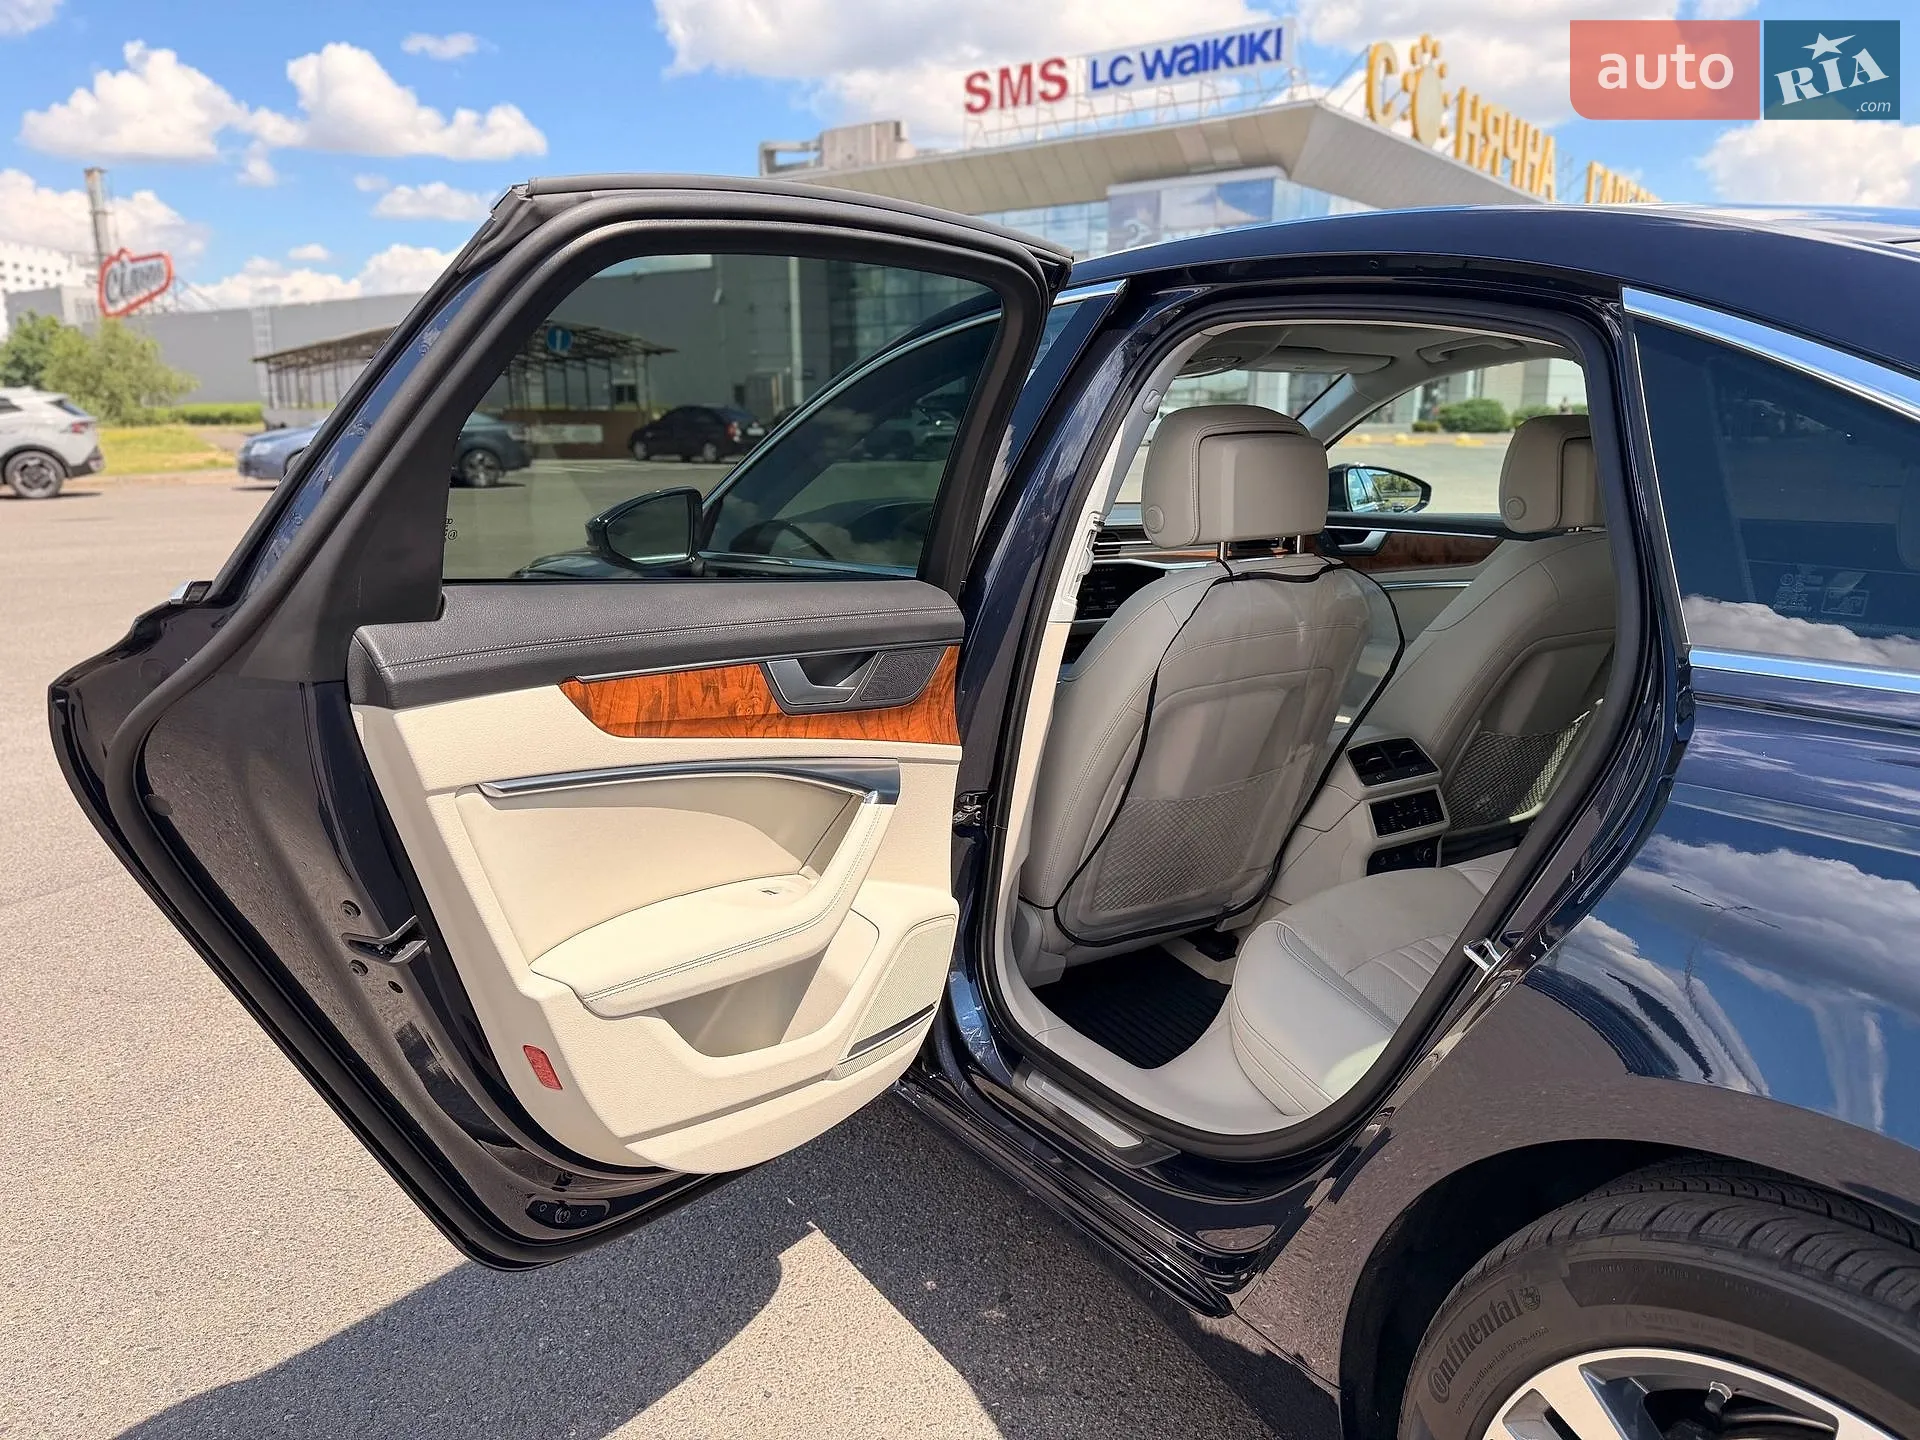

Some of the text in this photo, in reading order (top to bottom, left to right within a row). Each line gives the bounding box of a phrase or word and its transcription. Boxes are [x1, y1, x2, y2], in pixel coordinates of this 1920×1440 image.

[964, 57, 1069, 115] SMS
[1090, 55, 1133, 91] LC
[1427, 1288, 1525, 1404] Continental
